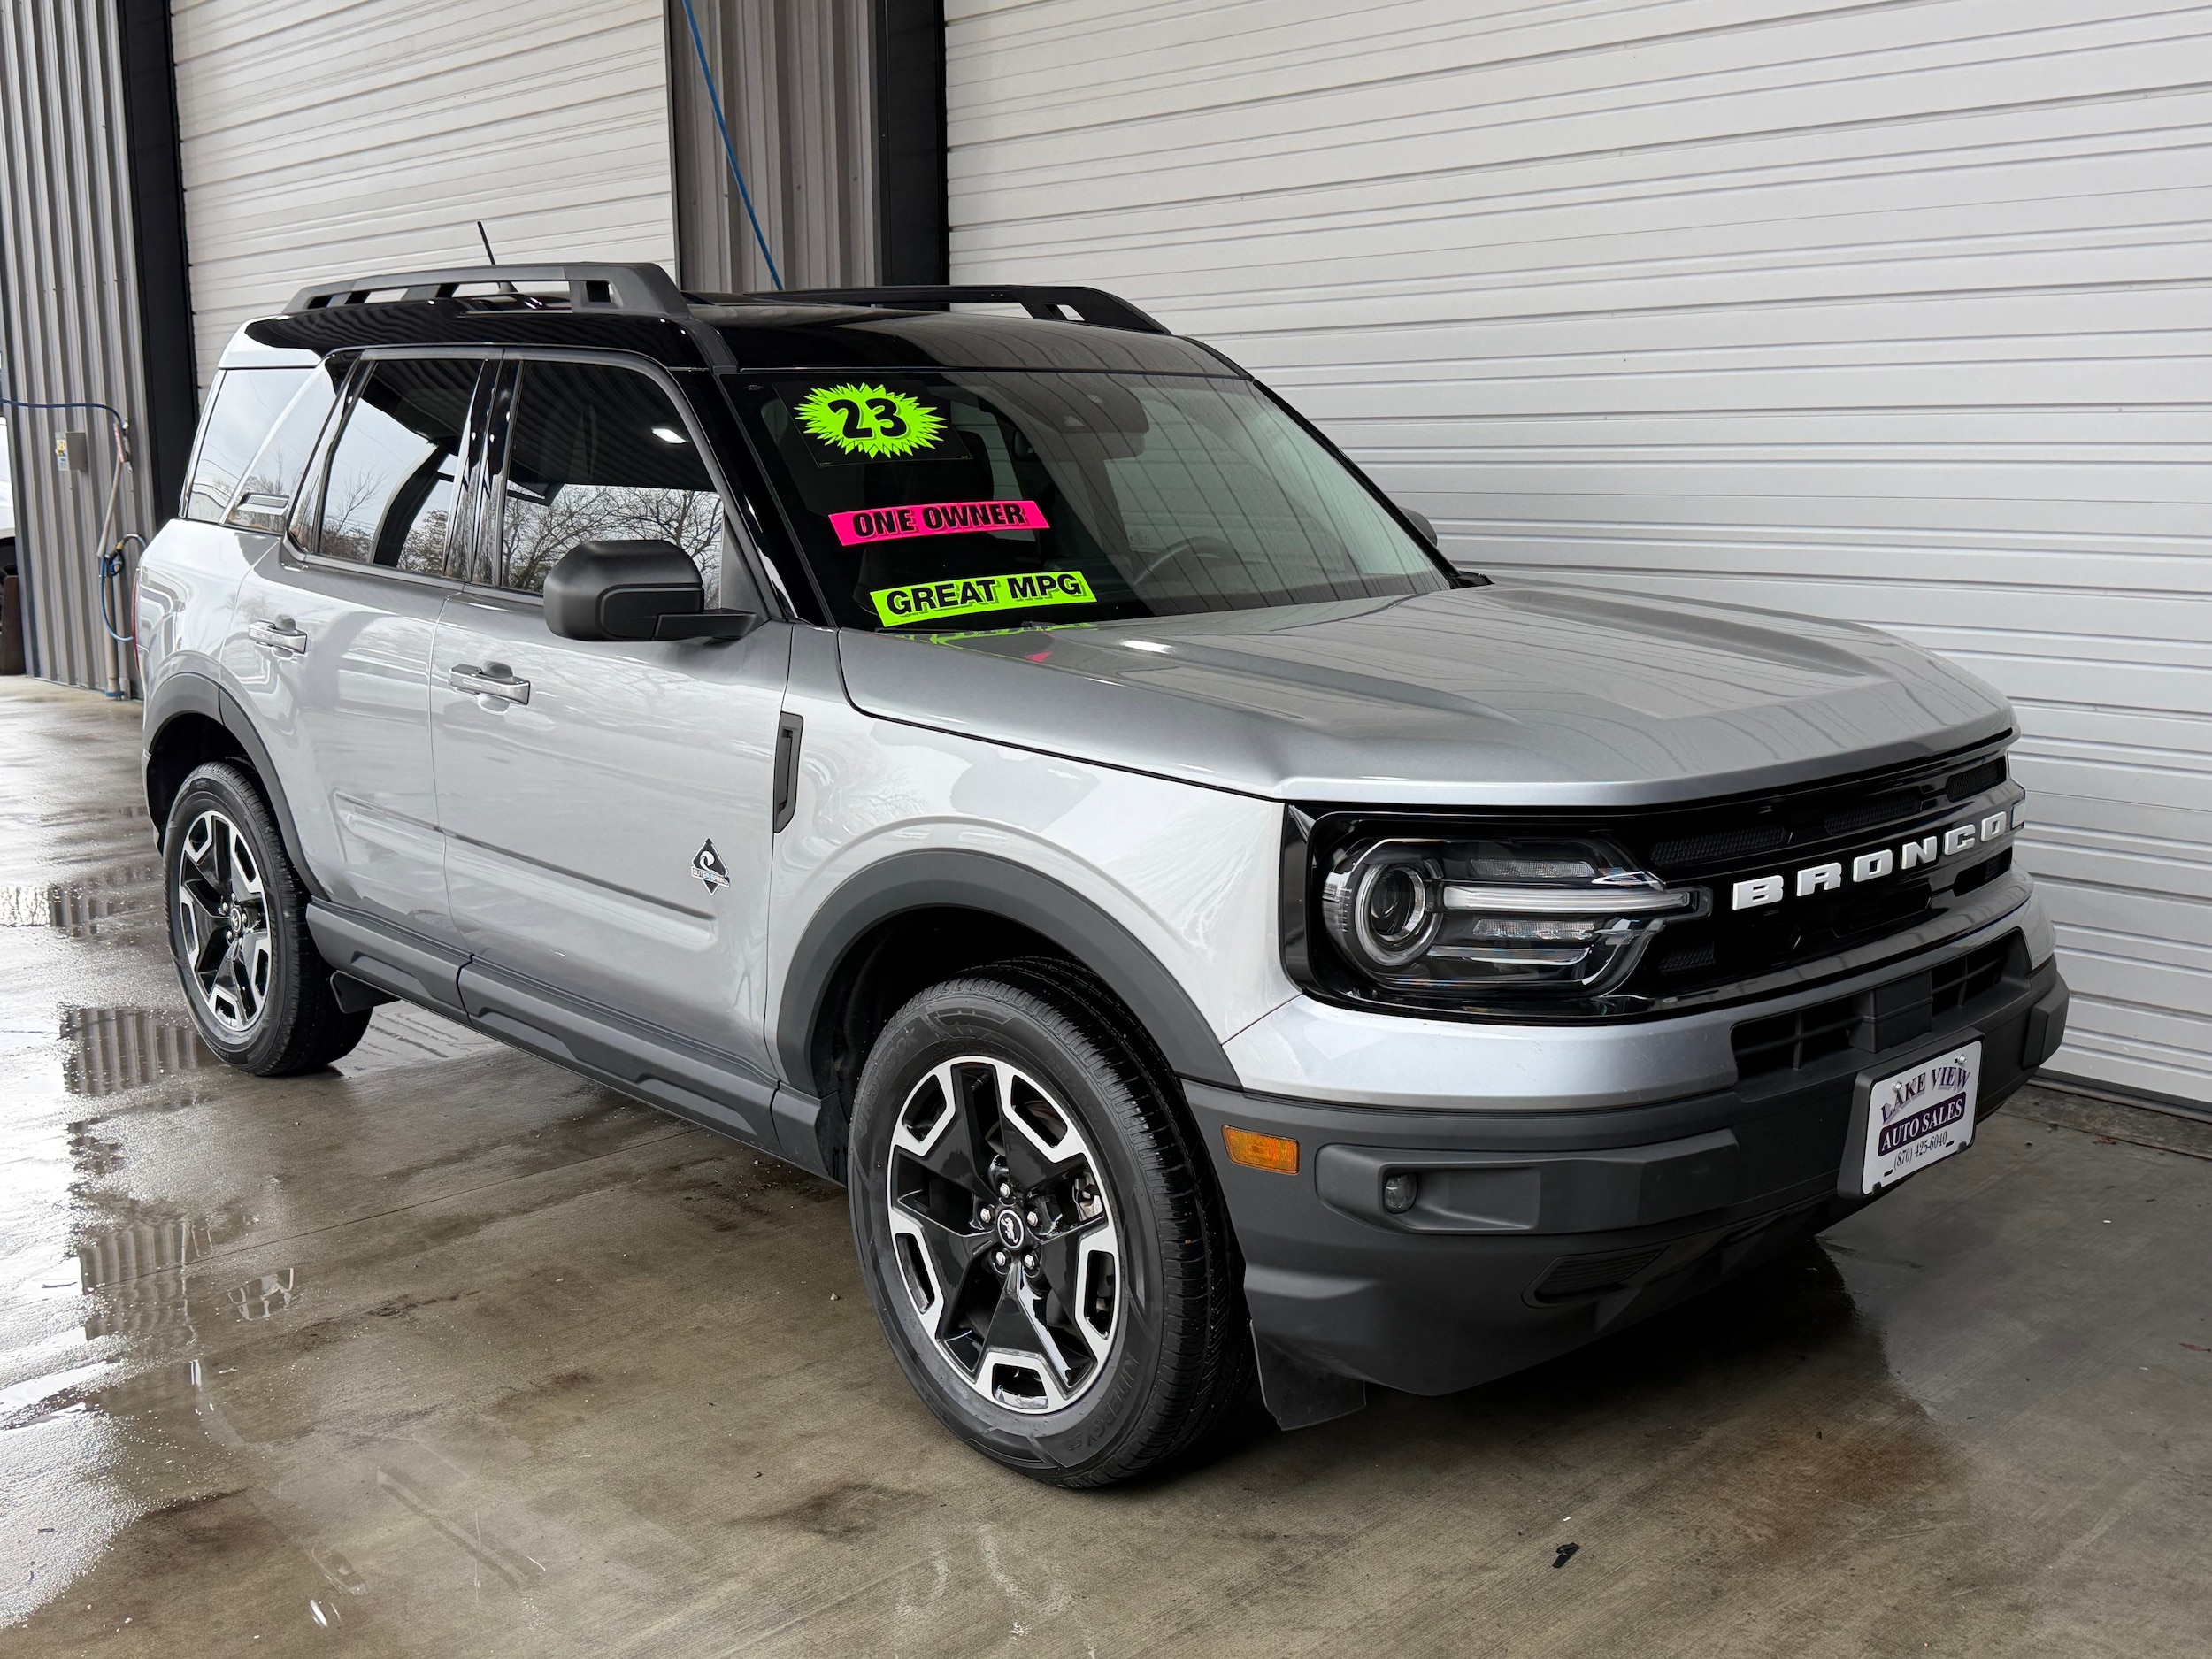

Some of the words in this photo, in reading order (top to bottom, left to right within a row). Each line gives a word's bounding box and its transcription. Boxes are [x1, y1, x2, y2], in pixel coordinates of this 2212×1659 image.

[828, 398, 908, 440] 23
[852, 510, 917, 538] ONE
[922, 503, 1026, 530] OWNER
[887, 580, 996, 616] GREAT
[1007, 574, 1082, 601] MPG
[1732, 811, 2007, 910] BRONCO
[1880, 1072, 1926, 1124] LAKE
[1931, 1066, 1970, 1091] VIEW
[1881, 1119, 1920, 1151] AUTO
[1922, 1098, 1962, 1132] SALES
[1893, 1148, 1912, 1171] (870)
